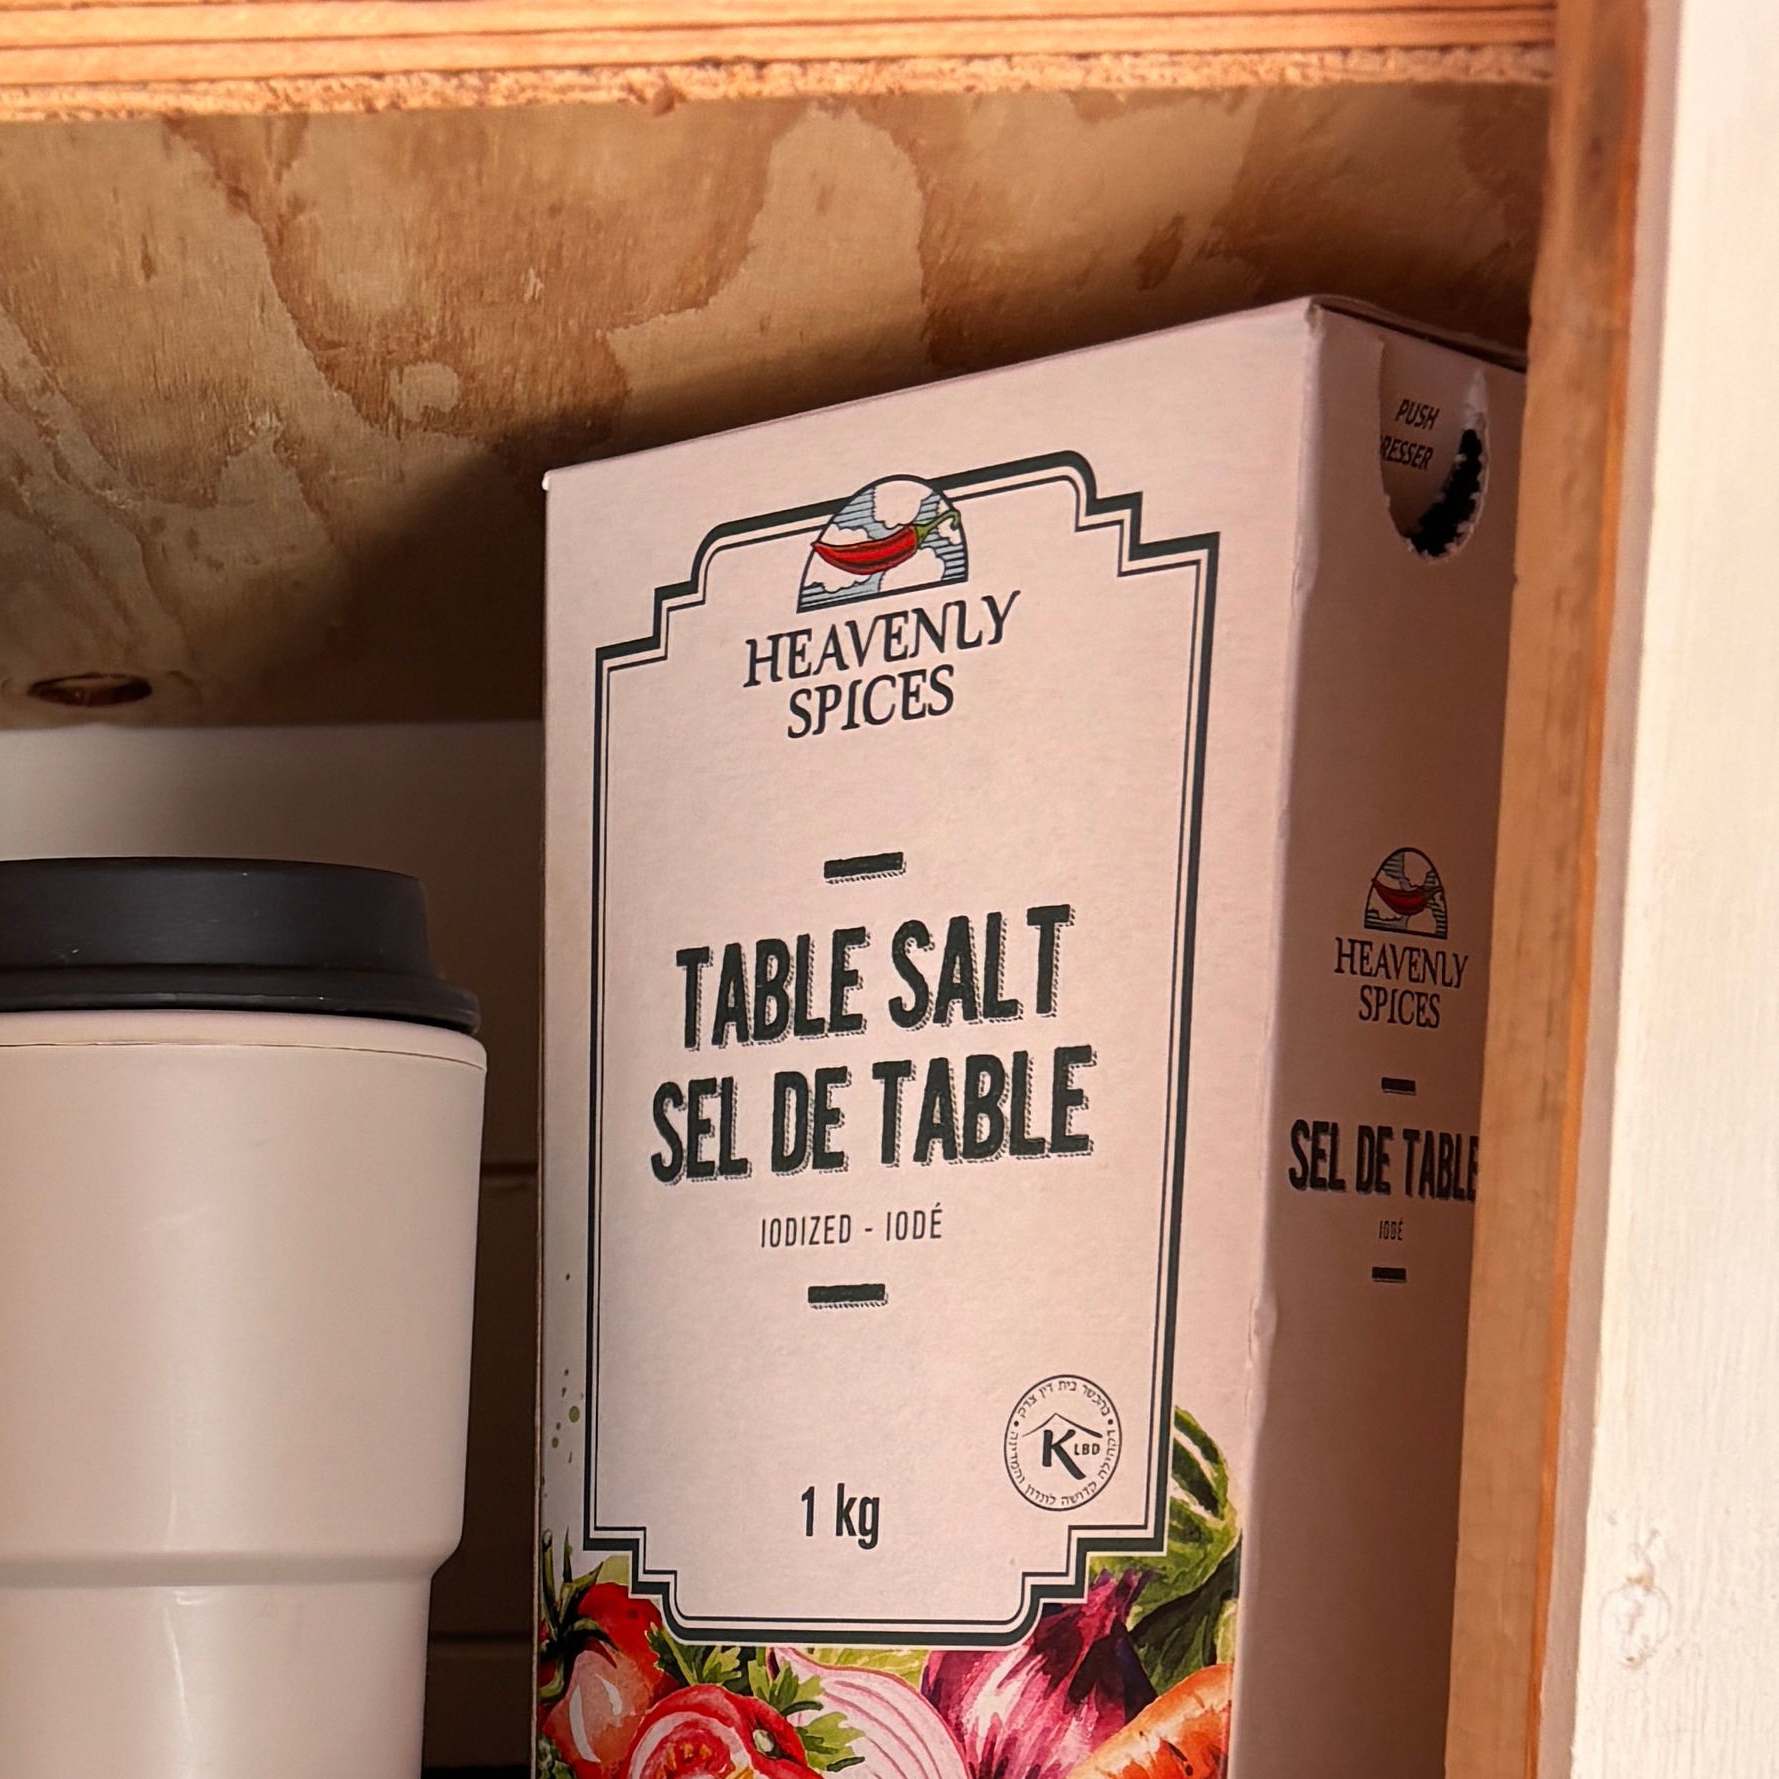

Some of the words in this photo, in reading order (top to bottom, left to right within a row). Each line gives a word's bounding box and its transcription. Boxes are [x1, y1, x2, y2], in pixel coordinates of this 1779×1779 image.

[1395, 398, 1440, 430] PUSH
[1380, 434, 1434, 471] RESSER
[743, 590, 1021, 688] HEAVENLY
[787, 664, 954, 739] SPICES
[675, 926, 871, 1052] TABLE
[888, 903, 1076, 1031] SALT
[1334, 936, 1469, 989] HEAVENLY
[1358, 984, 1442, 1029] SPICES
[650, 1075, 753, 1186] SEL
[771, 1066, 852, 1176] DE
[871, 1044, 1098, 1168] TABLE
[1288, 1119, 1347, 1193] SEL
[1356, 1124, 1393, 1196] DE
[760, 1214, 852, 1249] IODIZED
[886, 1202, 943, 1241] IODÉ
[1379, 1218, 1404, 1242] IODÉ
[1038, 1382, 1054, 1399] דין
[1058, 1380, 1078, 1392] בית
[1042, 1429, 1087, 1481] K
[1074, 1443, 1101, 1456] LBD
[801, 1485, 815, 1537] 1
[835, 1482, 881, 1550] kg
